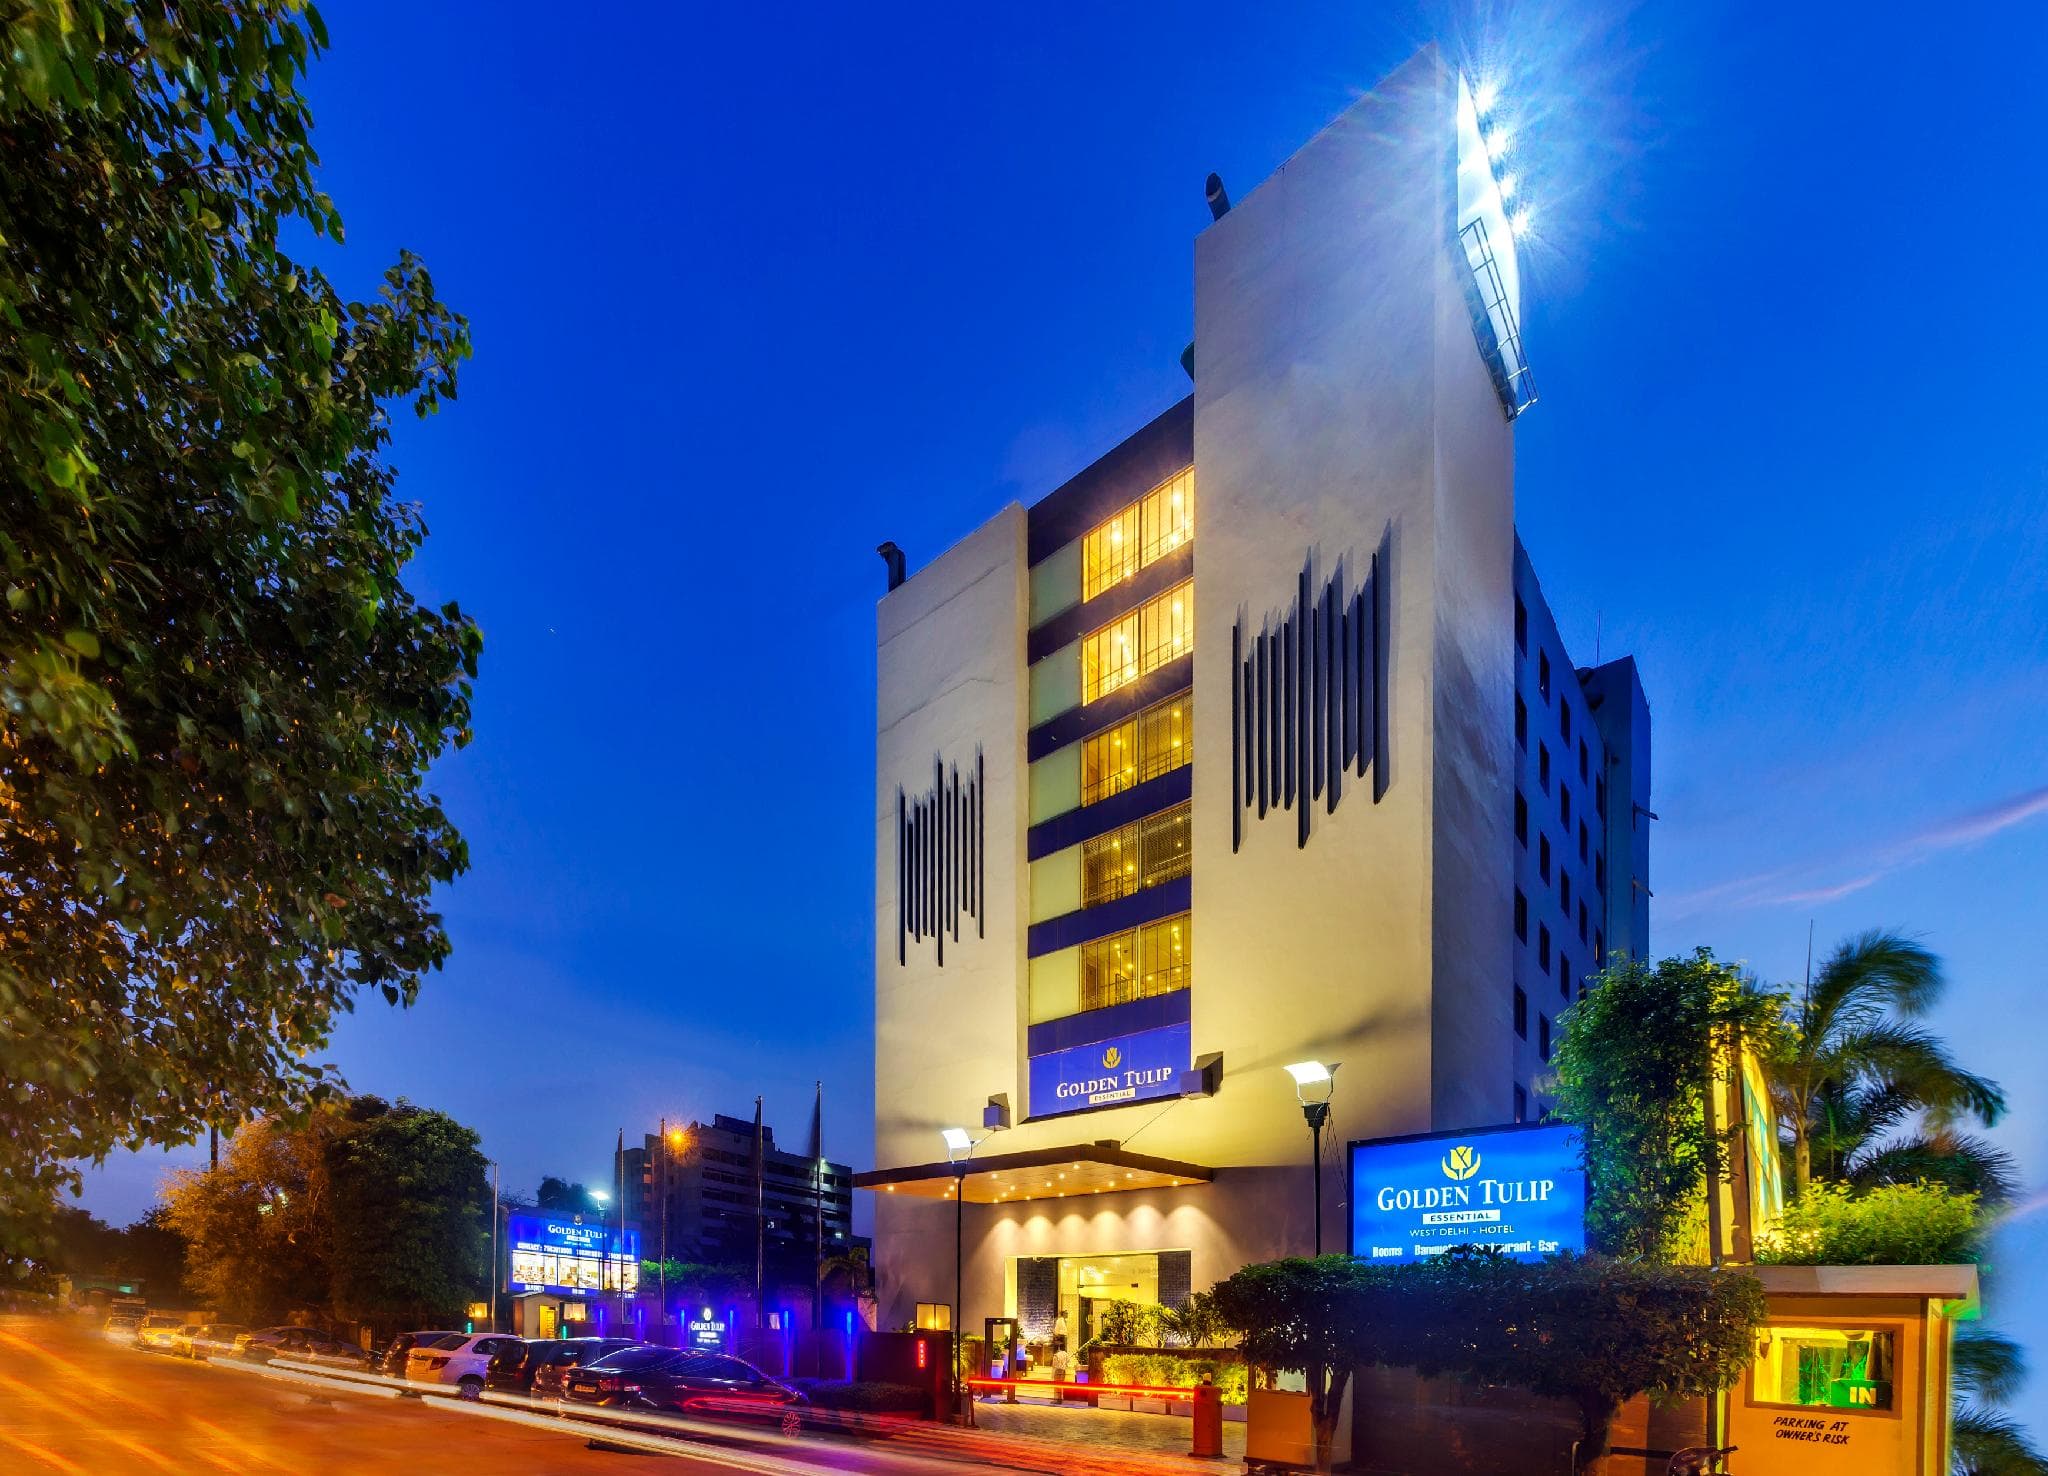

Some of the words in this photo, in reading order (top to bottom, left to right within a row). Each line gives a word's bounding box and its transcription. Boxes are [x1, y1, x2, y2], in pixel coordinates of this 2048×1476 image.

[1056, 1076, 1118, 1098] GOLDEN
[1124, 1067, 1172, 1087] TULIP
[1094, 1090, 1131, 1102] ESSENTIAL
[1377, 1185, 1470, 1211] GOLDEN
[1478, 1179, 1554, 1205] TULIP
[1430, 1211, 1492, 1223] ESSENTIAL
[548, 1224, 582, 1236] GOLDEN
[1409, 1228, 1436, 1237] WEST
[1439, 1227, 1469, 1236] DELHI
[1480, 1225, 1515, 1234] HOTEL
[1372, 1246, 1403, 1258] Rooms
[1538, 1239, 1559, 1252] Bar
[1849, 1387, 1877, 1405] IN
[1773, 1416, 1826, 1431] PARKING
[1829, 1421, 1849, 1431] AT
[1775, 1429, 1822, 1442] OWNER'S
[1822, 1434, 1850, 1445] RISK
